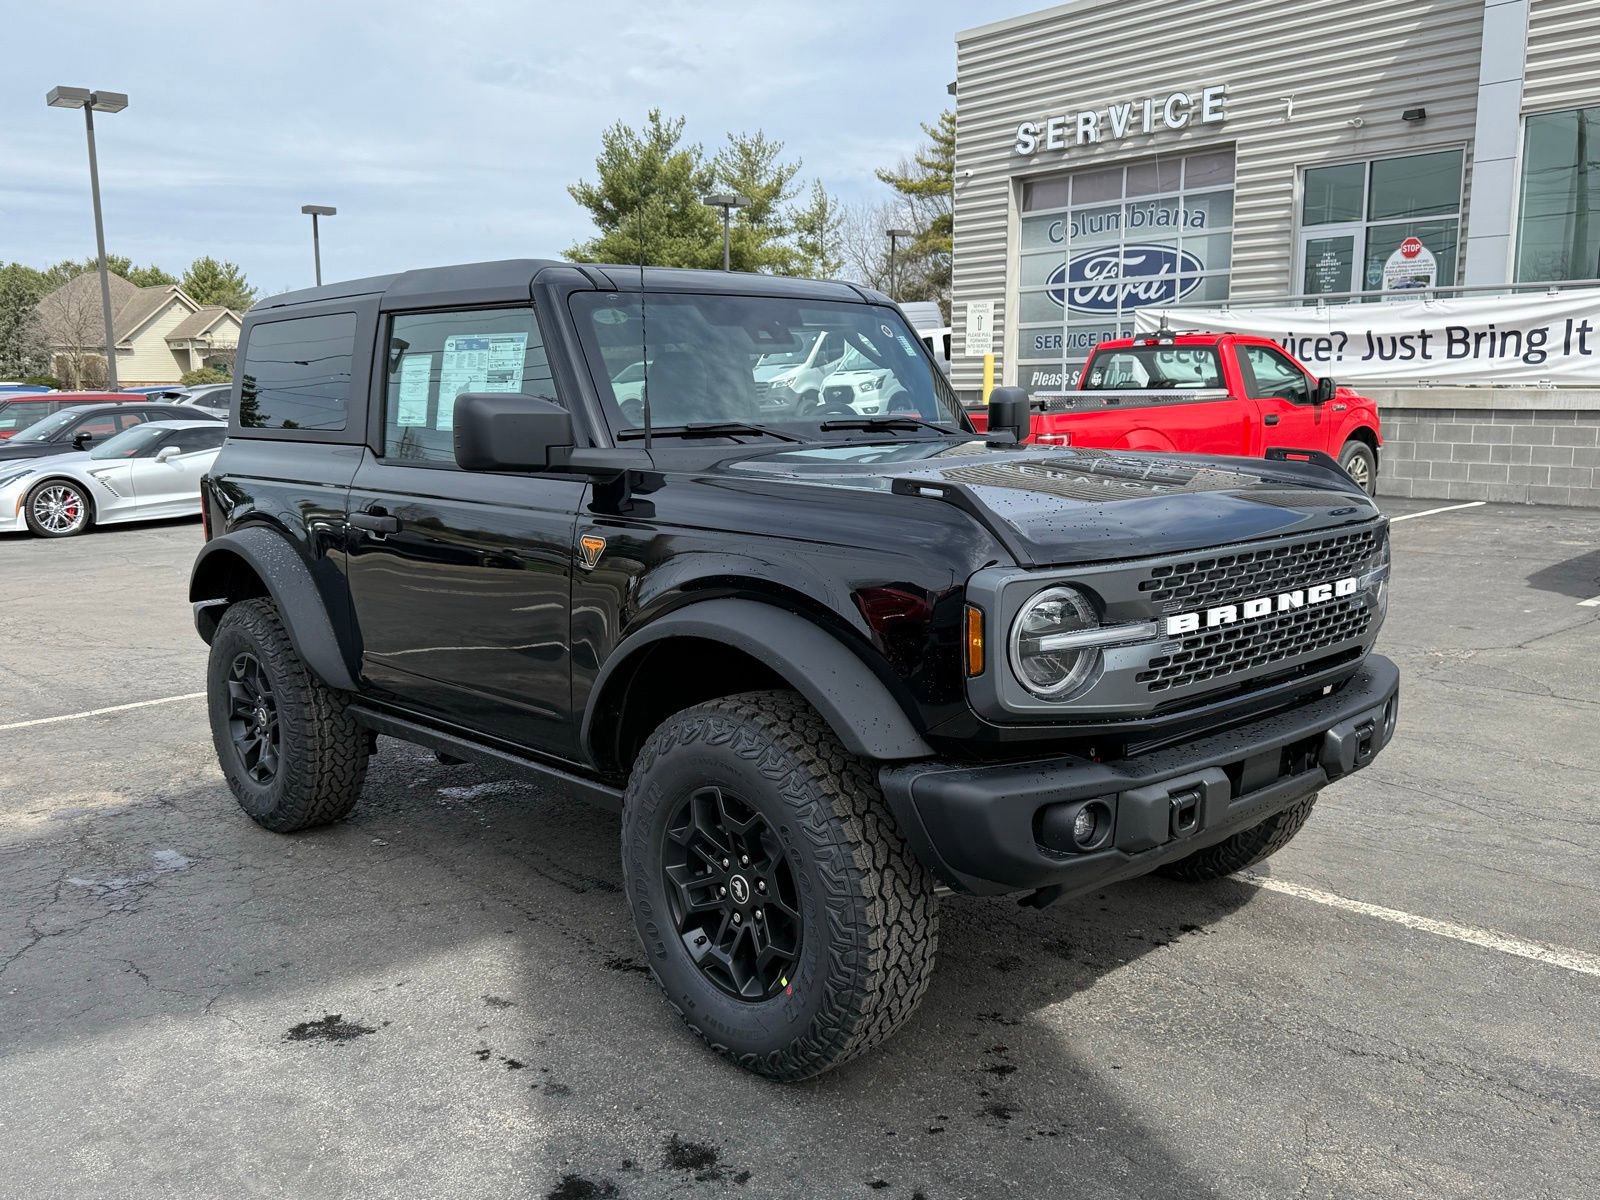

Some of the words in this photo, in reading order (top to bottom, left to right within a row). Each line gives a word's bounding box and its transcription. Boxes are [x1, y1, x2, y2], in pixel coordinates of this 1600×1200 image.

[1015, 84, 1226, 155] SERVICE
[1048, 203, 1206, 243] Columbiana
[1402, 244, 1420, 253] STOP
[1073, 254, 1171, 304] Ford
[1035, 333, 1097, 350] SERVICE
[1362, 329, 1432, 361] Just
[1445, 323, 1549, 365] Bring
[1564, 318, 1593, 356] It
[1031, 371, 1069, 386] Please
[1166, 577, 1357, 636] BRONCO
